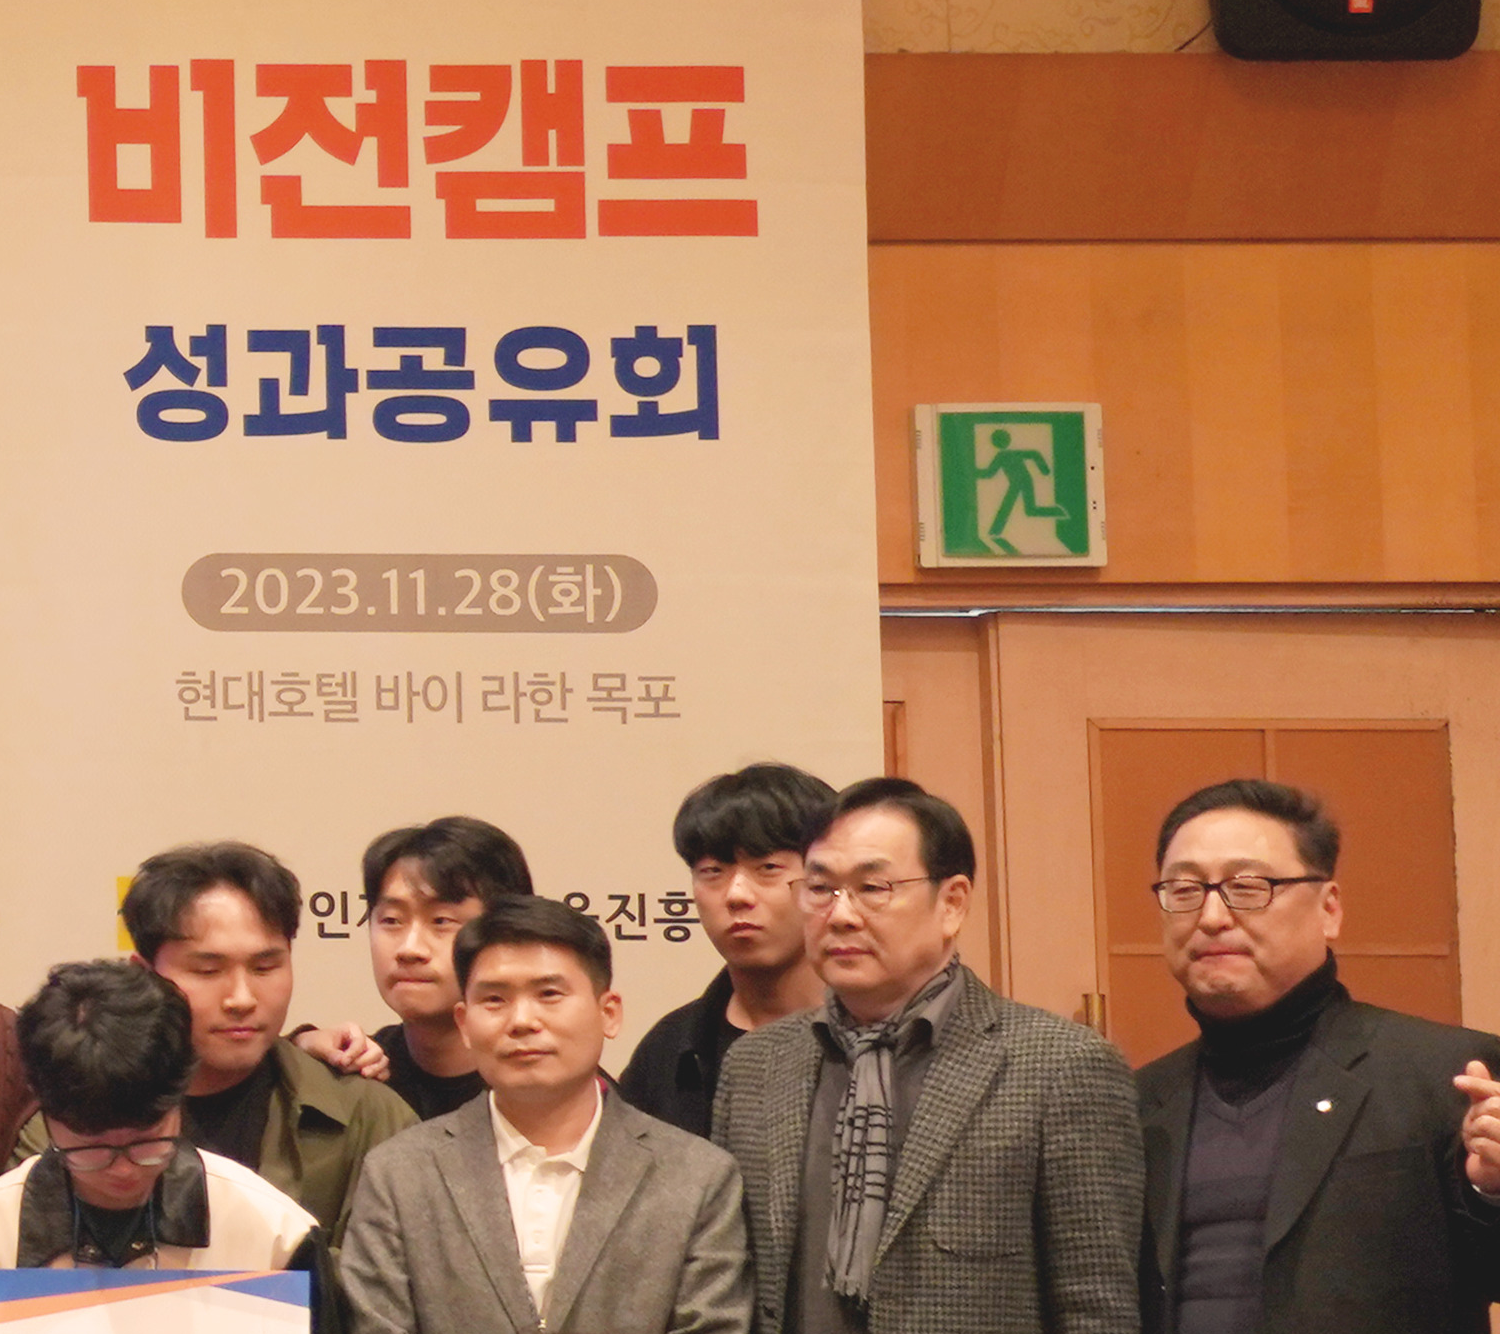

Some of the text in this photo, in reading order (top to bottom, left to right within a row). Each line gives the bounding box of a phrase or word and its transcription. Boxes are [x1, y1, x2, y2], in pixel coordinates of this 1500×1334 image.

[77, 59, 758, 239] 비전캠프
[123, 324, 719, 443] 성과공유회
[221, 564, 621, 623] 2023.11.28(화)
[176, 670, 681, 724] 현대호텔 바이 라한 목포
